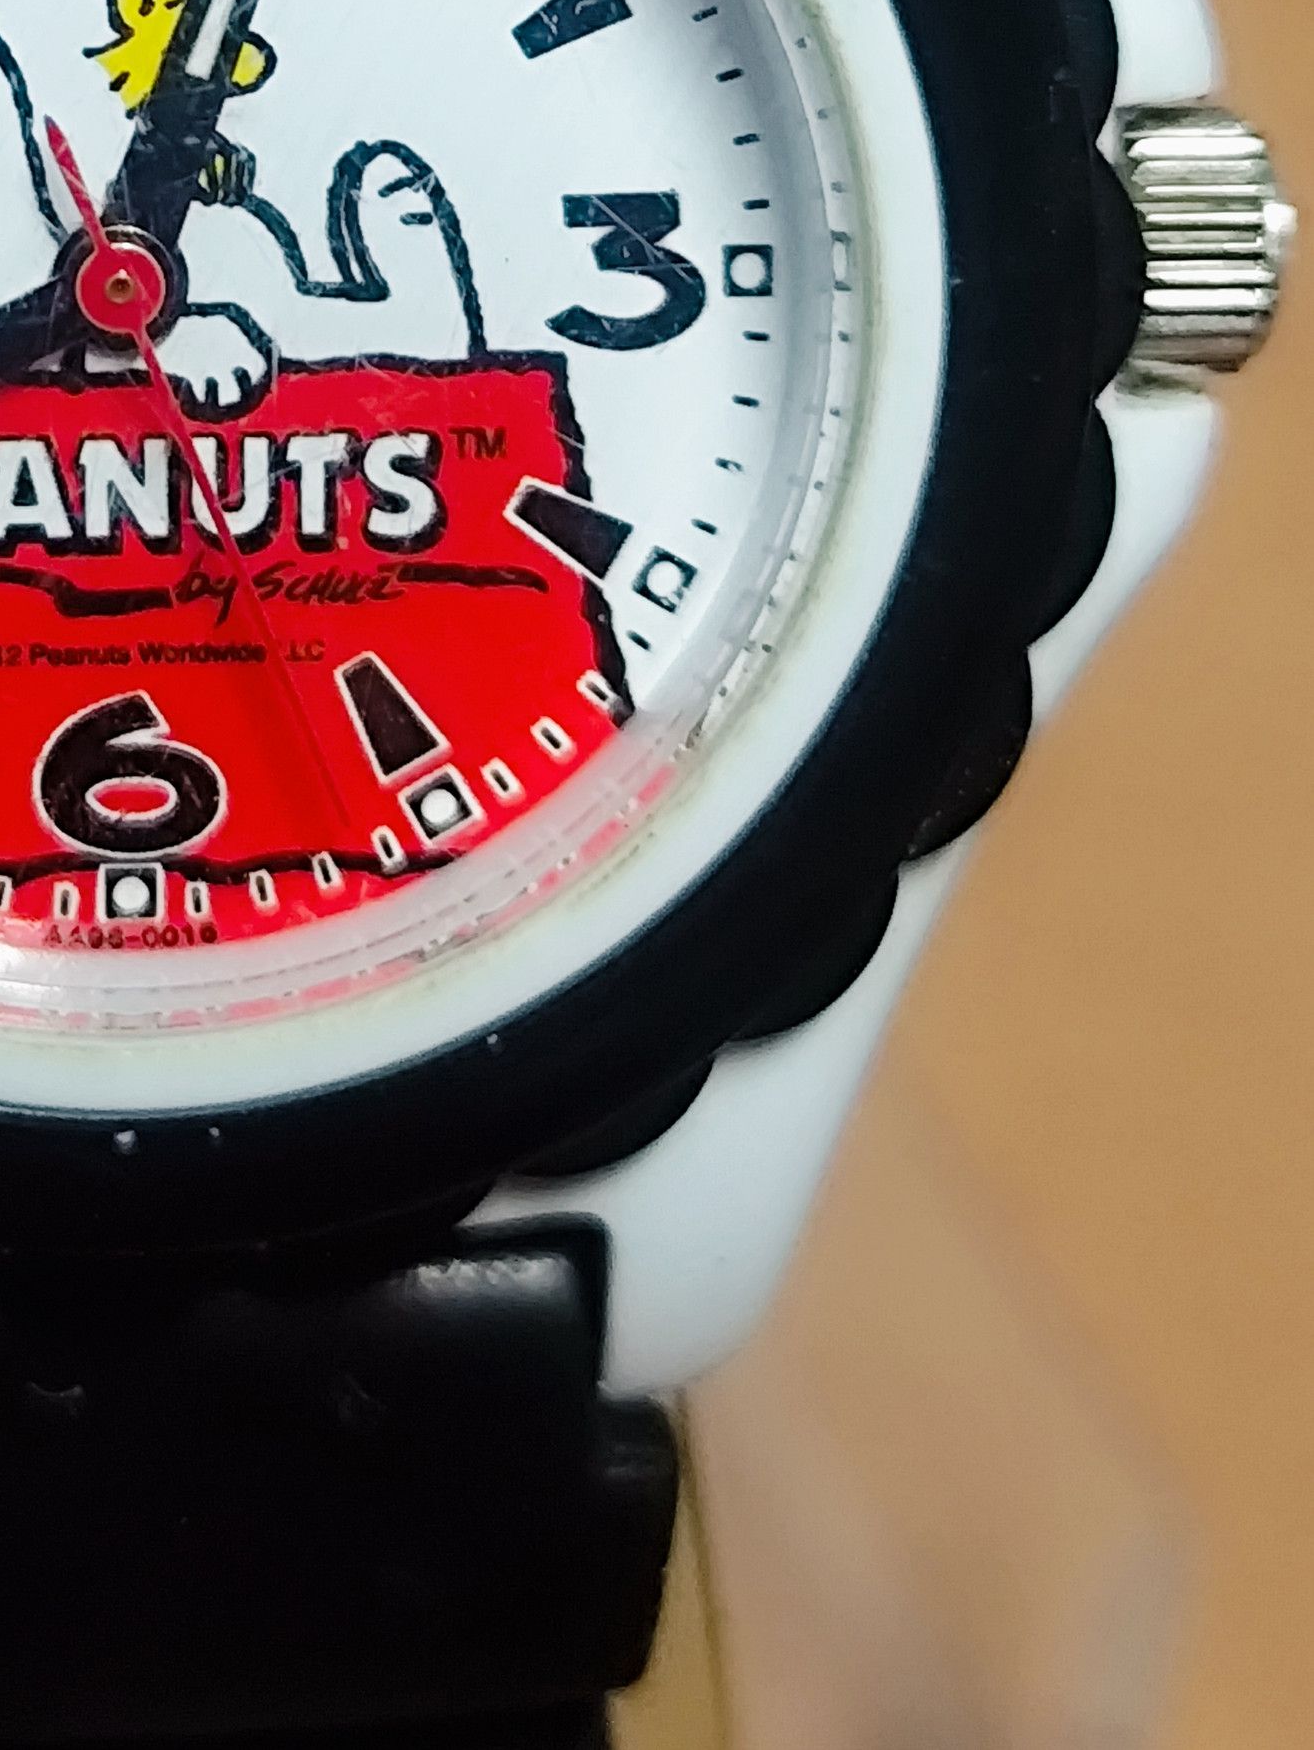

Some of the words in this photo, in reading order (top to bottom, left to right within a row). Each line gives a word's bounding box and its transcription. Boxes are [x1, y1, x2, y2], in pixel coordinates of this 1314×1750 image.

[544, 190, 706, 352] 3
[174, 553, 239, 628] by
[30, 643, 132, 666] Peanuts
[136, 640, 267, 665] Worldwide
[273, 638, 325, 662] LC
[31, 688, 229, 860] 6
